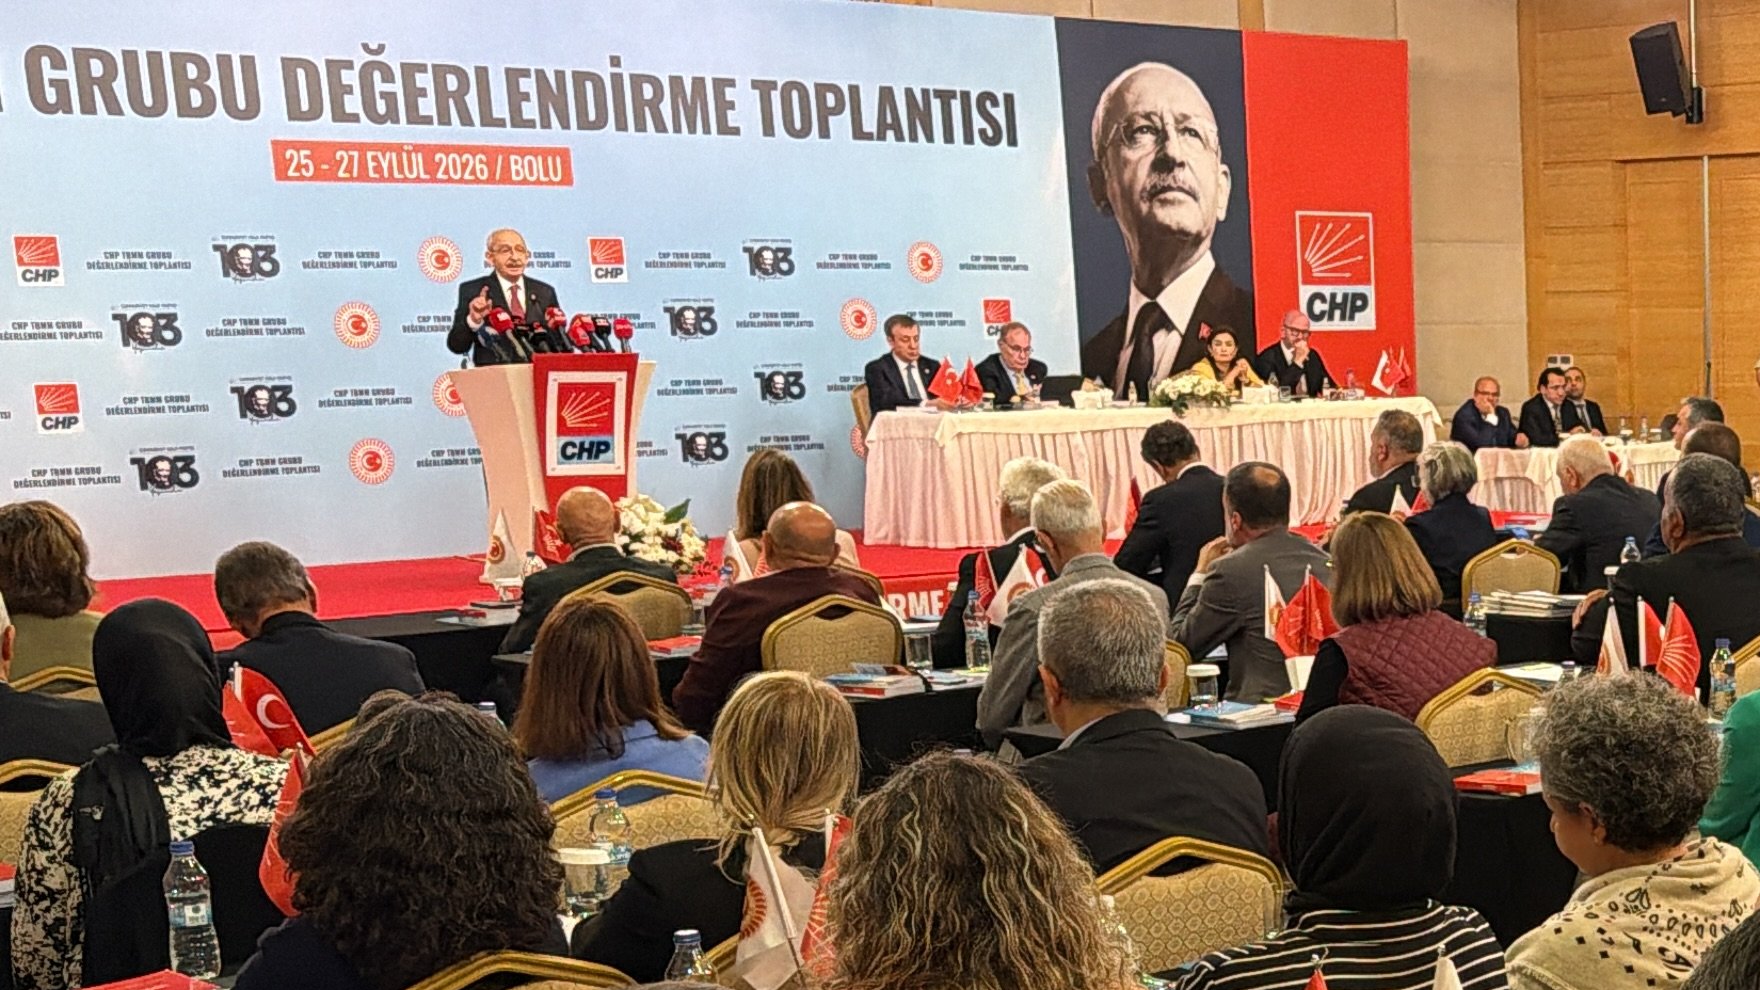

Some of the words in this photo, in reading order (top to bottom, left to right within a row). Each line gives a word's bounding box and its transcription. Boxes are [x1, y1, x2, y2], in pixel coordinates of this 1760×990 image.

[24, 44, 261, 121] GRUBU
[280, 42, 741, 138] DEĞERLENDİRME
[751, 79, 1019, 148] TOPLANTISI
[285, 149, 314, 178] 25
[335, 150, 359, 178] 27
[366, 145, 430, 180] EYLÜL
[434, 152, 488, 180] 2026
[495, 153, 503, 181] /
[510, 154, 562, 182] BOLU
[21, 268, 60, 283] CHP
[595, 267, 623, 279] CHP
[1306, 292, 1369, 322] CHP
[0, 330, 57, 341] EĞERLENDİRME
[402, 323, 451, 334] DEĞERLENDİR
[41, 415, 79, 430] CHP
[467, 448, 481, 456] GRU
[561, 440, 611, 461] CHP
